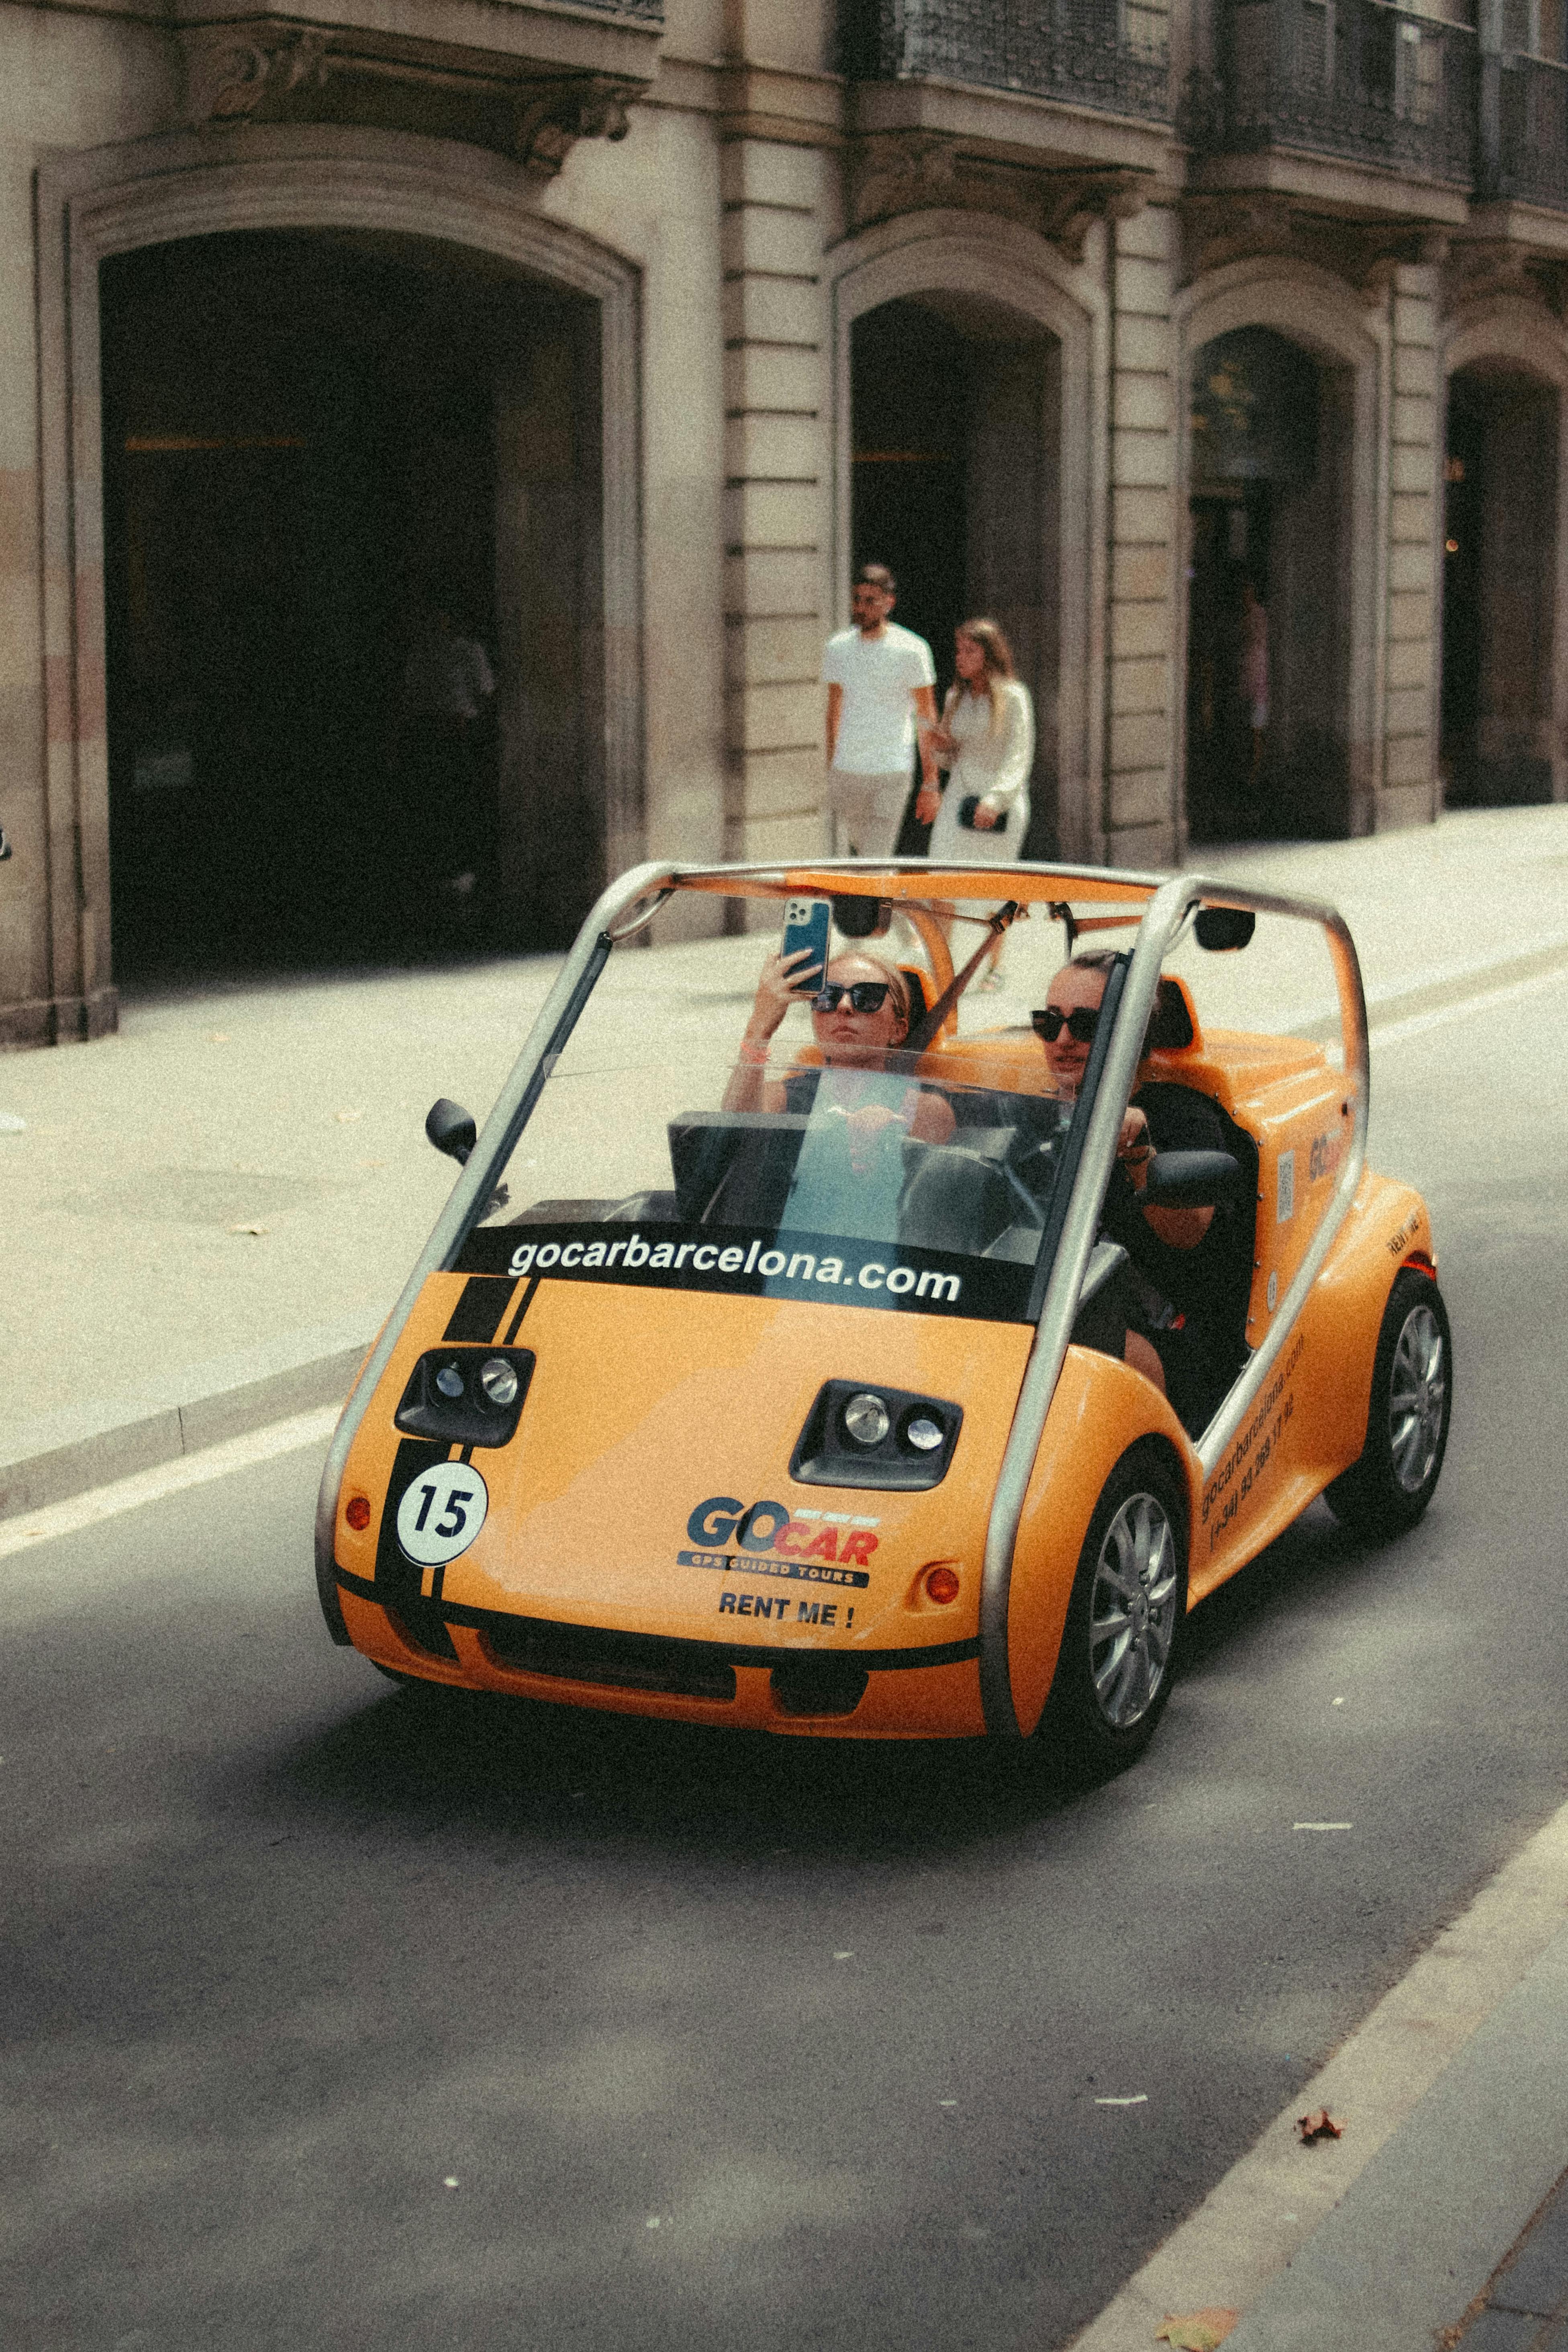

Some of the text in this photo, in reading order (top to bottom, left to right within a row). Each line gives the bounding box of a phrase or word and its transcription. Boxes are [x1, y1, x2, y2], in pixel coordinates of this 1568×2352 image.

[508, 1234, 962, 1302] gocarbarcelona.com
[414, 1484, 474, 1537] 15
[691, 1554, 854, 1583] GPS GUIDED TOURS
[719, 1592, 790, 1620] RENT
[797, 1601, 838, 1627] ME
